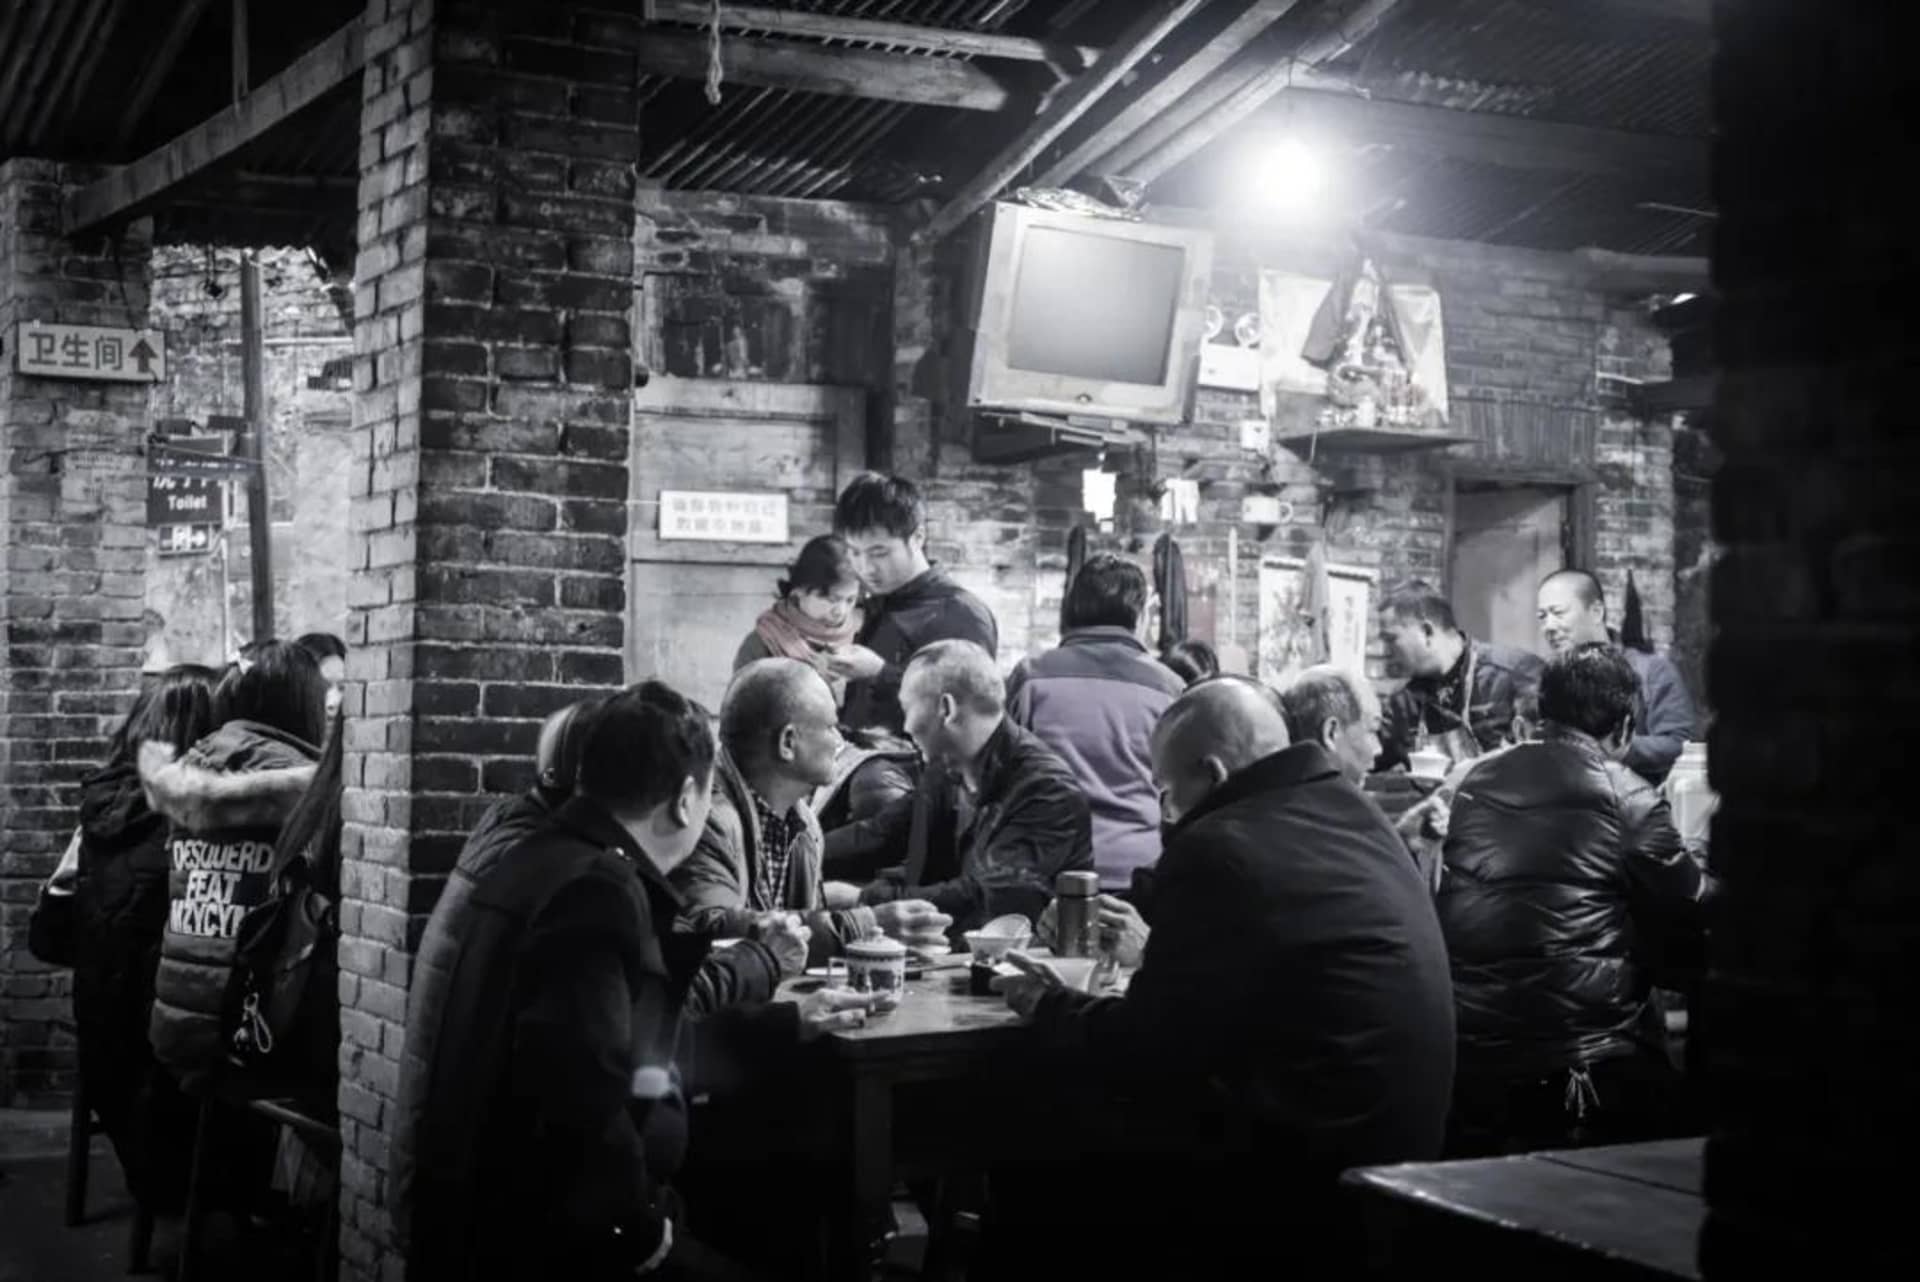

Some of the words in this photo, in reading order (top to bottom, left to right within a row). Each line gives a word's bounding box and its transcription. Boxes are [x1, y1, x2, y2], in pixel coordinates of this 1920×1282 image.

[28, 332, 123, 370] 卫生间
[167, 495, 207, 511] Toilet
[186, 869, 242, 904] FEAT
